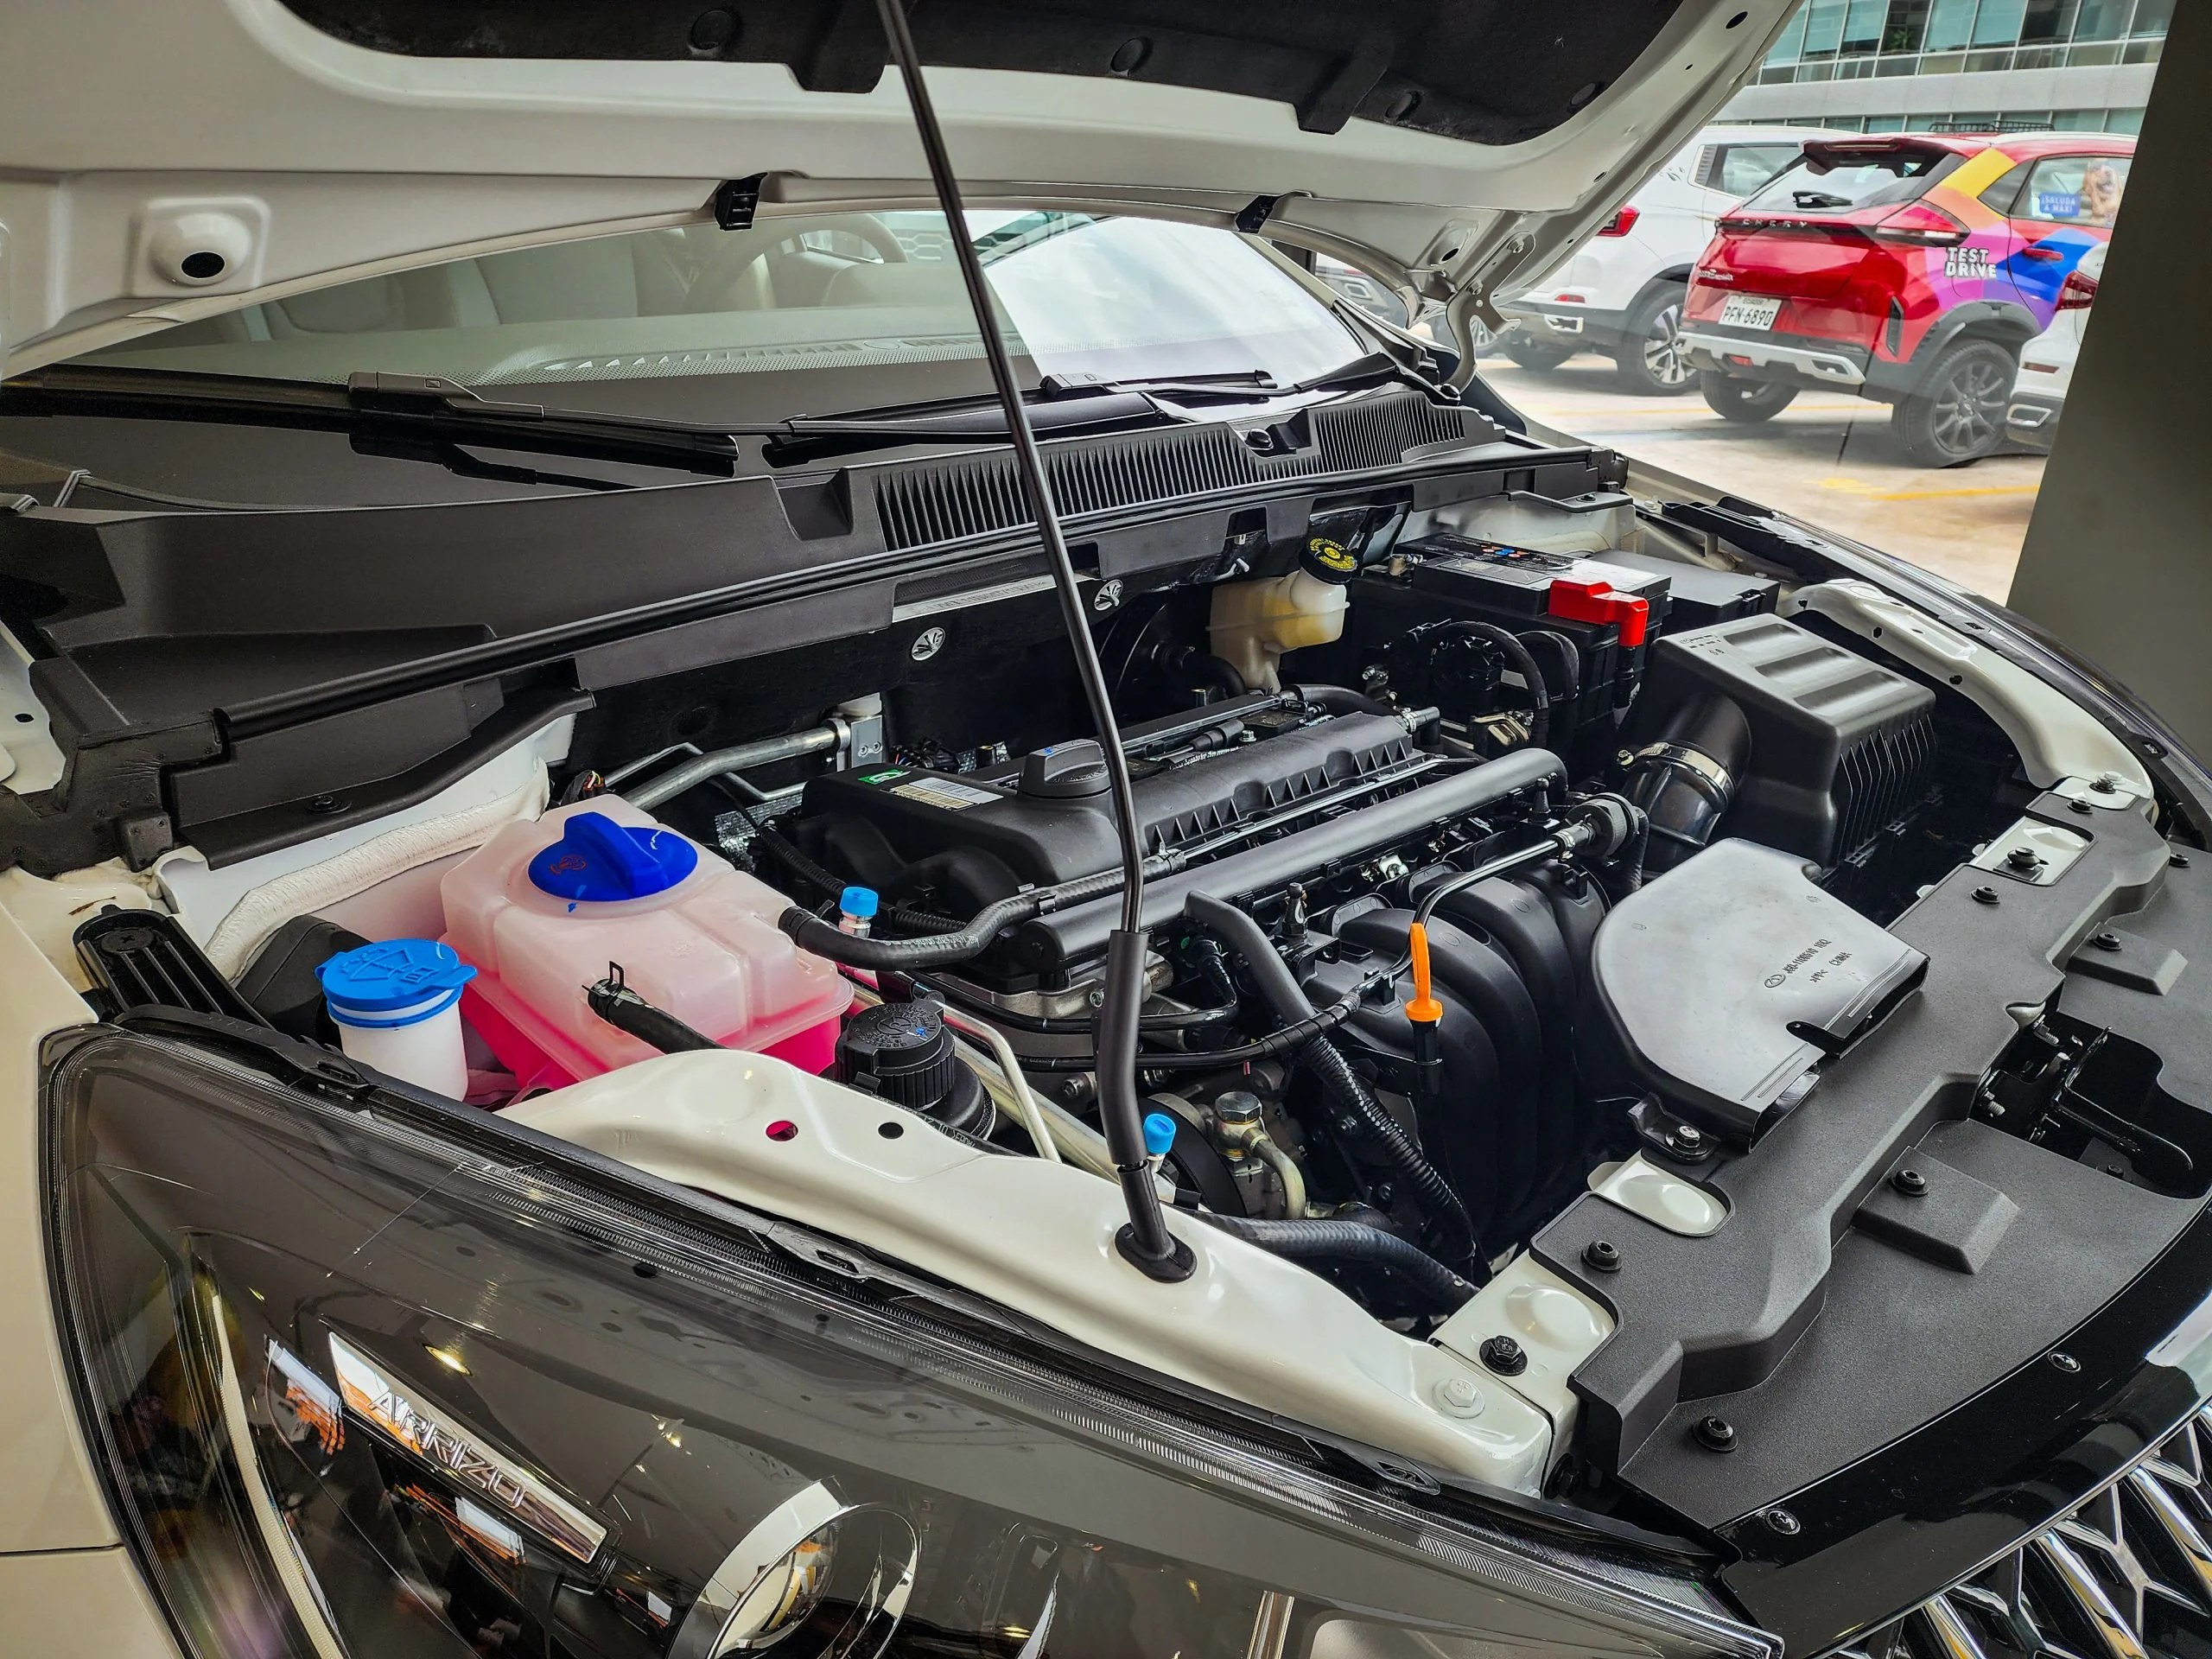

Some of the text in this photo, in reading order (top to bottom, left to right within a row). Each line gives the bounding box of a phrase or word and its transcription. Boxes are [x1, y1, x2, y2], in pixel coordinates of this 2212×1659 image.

[1946, 246, 1990, 264] TEST
[1944, 261, 1998, 279] DRIVE
[1723, 306, 1774, 327] PFN-6890
[367, 1390, 526, 1510] ARRIZO
